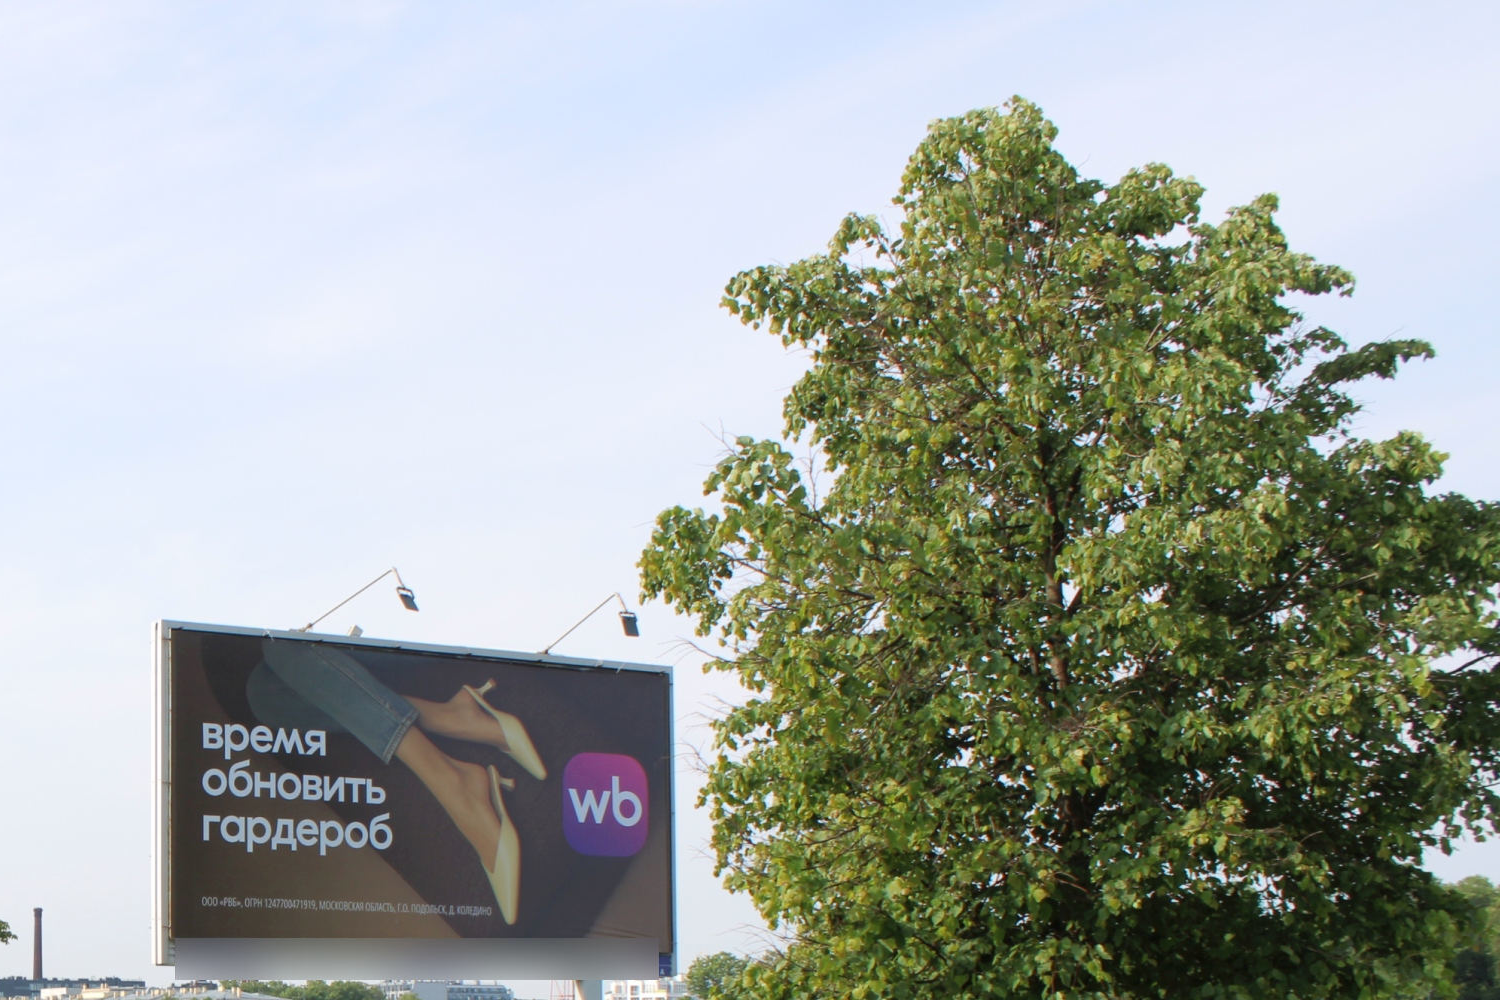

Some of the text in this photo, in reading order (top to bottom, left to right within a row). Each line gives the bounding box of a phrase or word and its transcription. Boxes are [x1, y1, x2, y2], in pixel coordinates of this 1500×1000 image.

[202, 722, 327, 760] время
[202, 759, 386, 804] обновить
[568, 775, 642, 826] wb
[202, 812, 393, 856] гардероб
[201, 896, 218, 907] ООО
[244, 898, 262, 908] ОГРН
[319, 900, 364, 911] МОСКОВСКАЯ
[457, 905, 492, 916] КОЛЕДИНО
